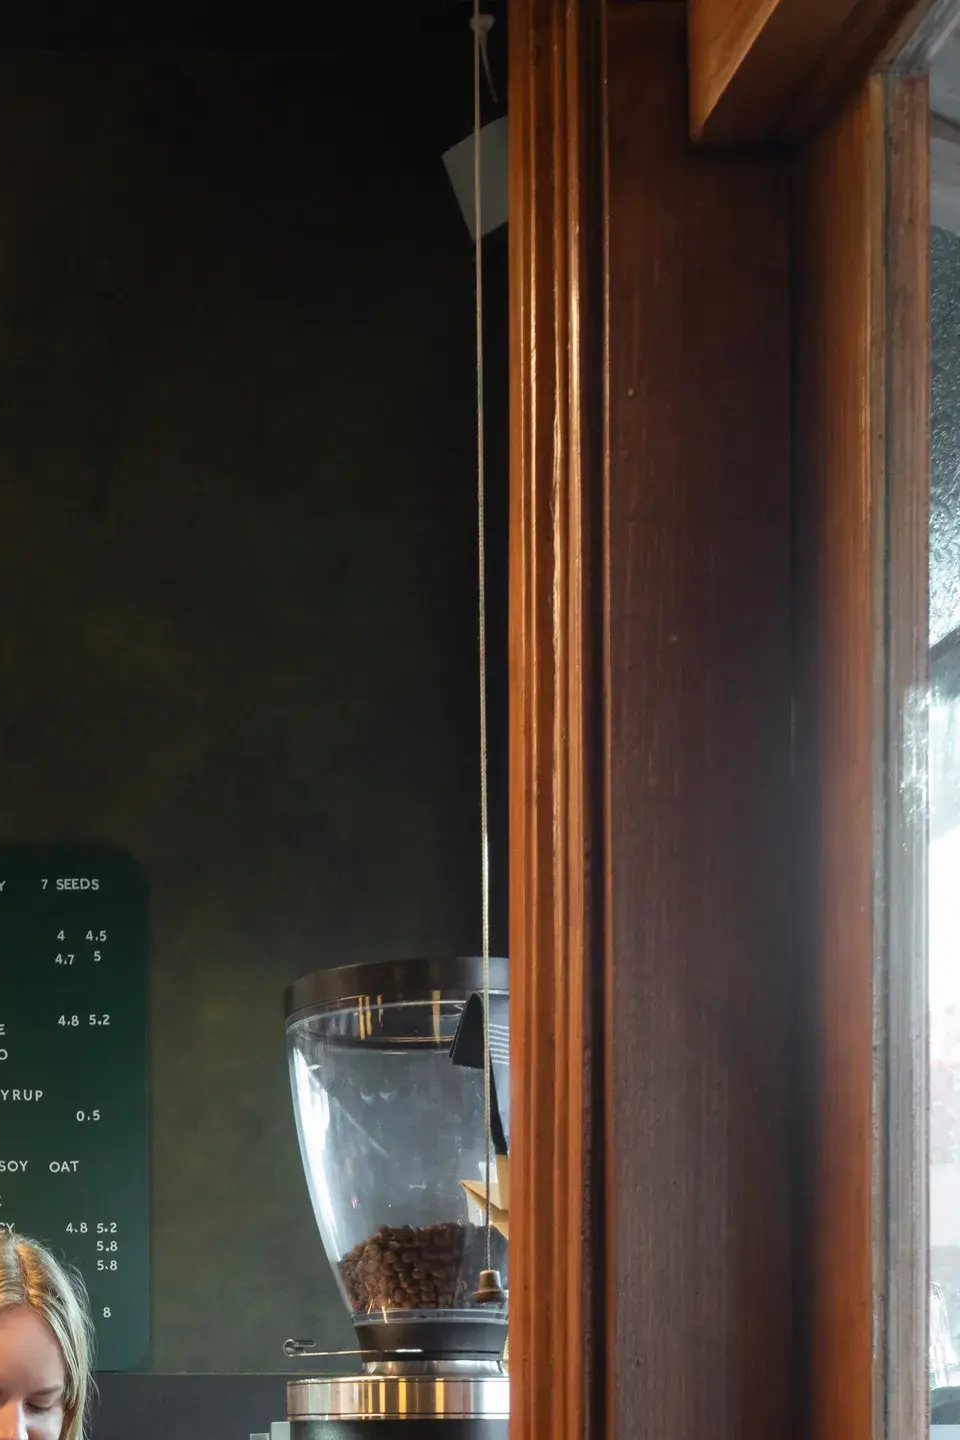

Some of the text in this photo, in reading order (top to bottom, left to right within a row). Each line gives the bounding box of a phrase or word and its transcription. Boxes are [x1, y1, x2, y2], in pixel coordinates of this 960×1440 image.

[40, 878, 49, 890] 7
[55, 877, 100, 891] SEEDS
[56, 929, 66, 941] 4
[85, 929, 107, 942] 4.5
[54, 953, 75, 966] 4.7
[93, 950, 102, 962] 5
[57, 1014, 80, 1027] 4.8
[88, 1013, 110, 1026] 5.2
[76, 1109, 101, 1122] 0.5
[48, 1160, 80, 1174] OAT
[65, 1221, 89, 1234] 4.8
[96, 1221, 118, 1234] 5.2
[96, 1240, 118, 1252] 5.8
[96, 1259, 118, 1271] 5.8
[102, 1306, 112, 1319] 8
